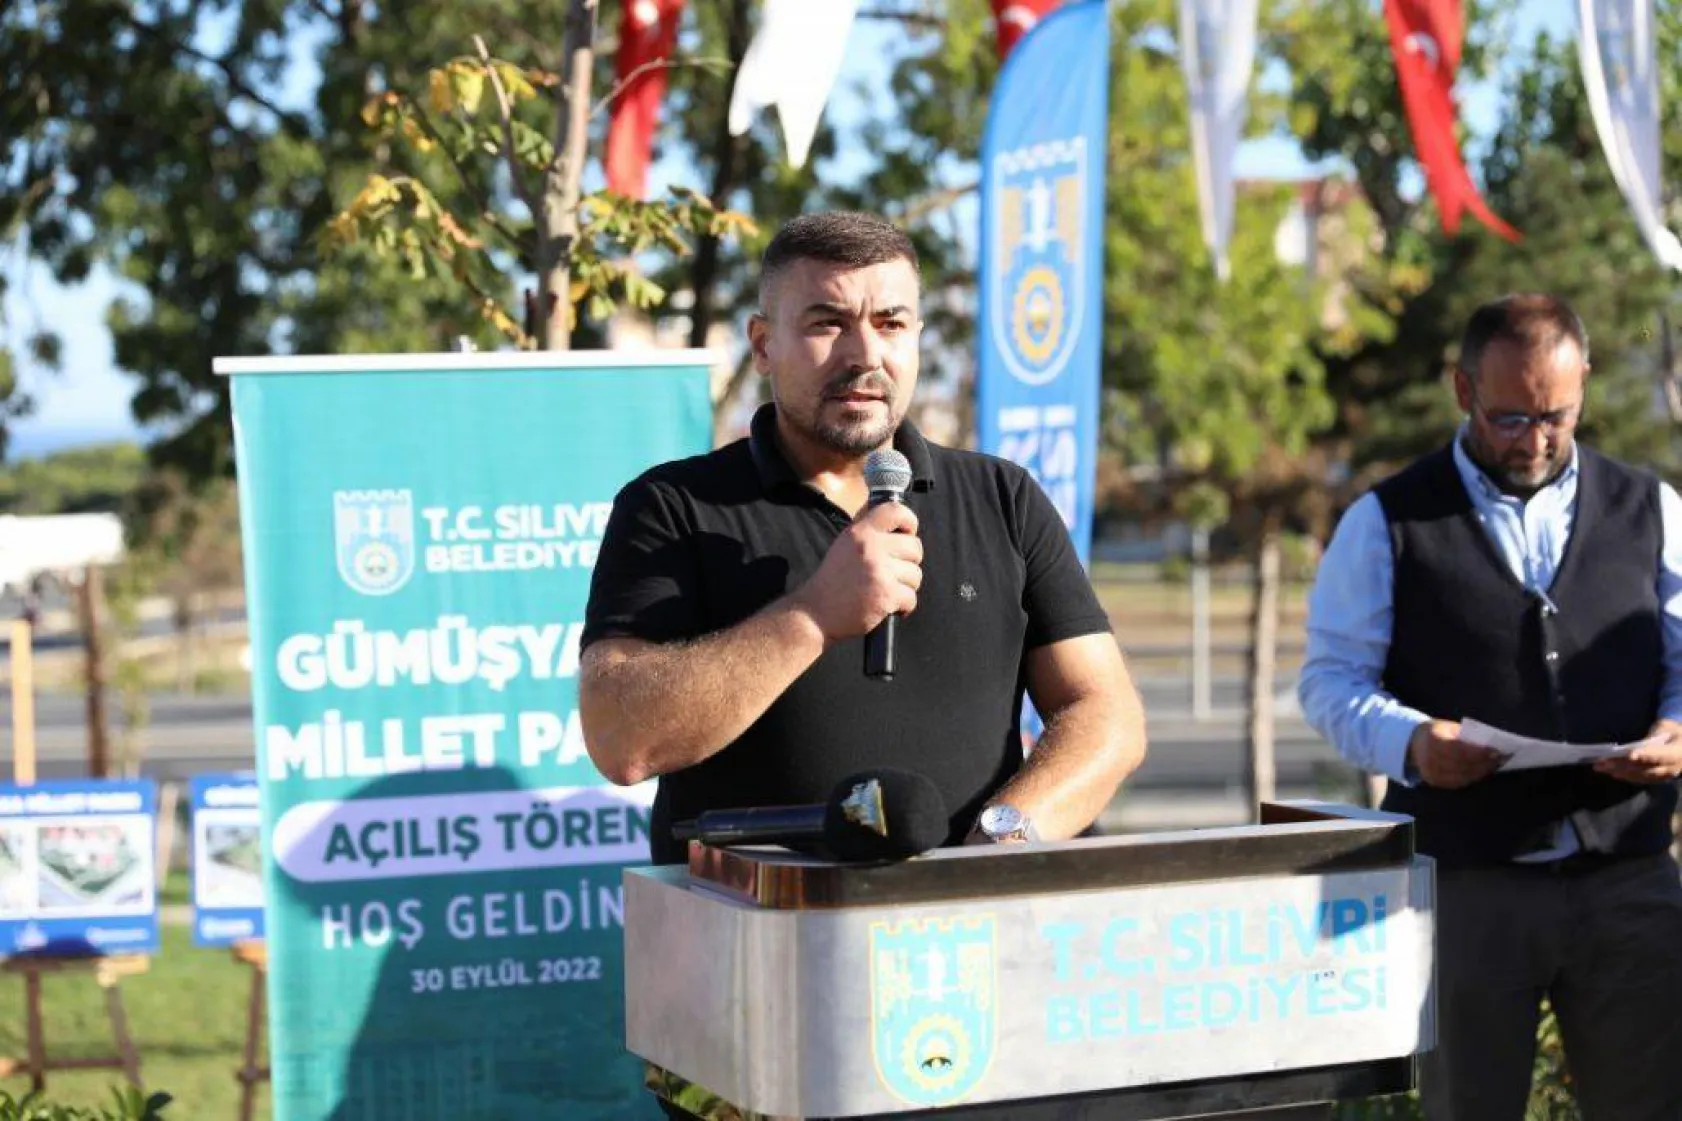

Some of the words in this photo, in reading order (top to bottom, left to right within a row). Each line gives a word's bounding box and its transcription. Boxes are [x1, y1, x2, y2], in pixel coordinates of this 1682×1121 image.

[422, 506, 493, 541] T.C.
[266, 709, 506, 780] MİLLET
[323, 815, 480, 868] AÇILIŞ
[494, 802, 653, 852] TÖREN
[322, 898, 425, 949] HOŞ
[446, 880, 623, 940] GELDİN
[411, 969, 444, 993] 30
[451, 959, 532, 990] EYLÜL
[538, 957, 602, 982] 2022
[1041, 917, 1155, 981] T.C.
